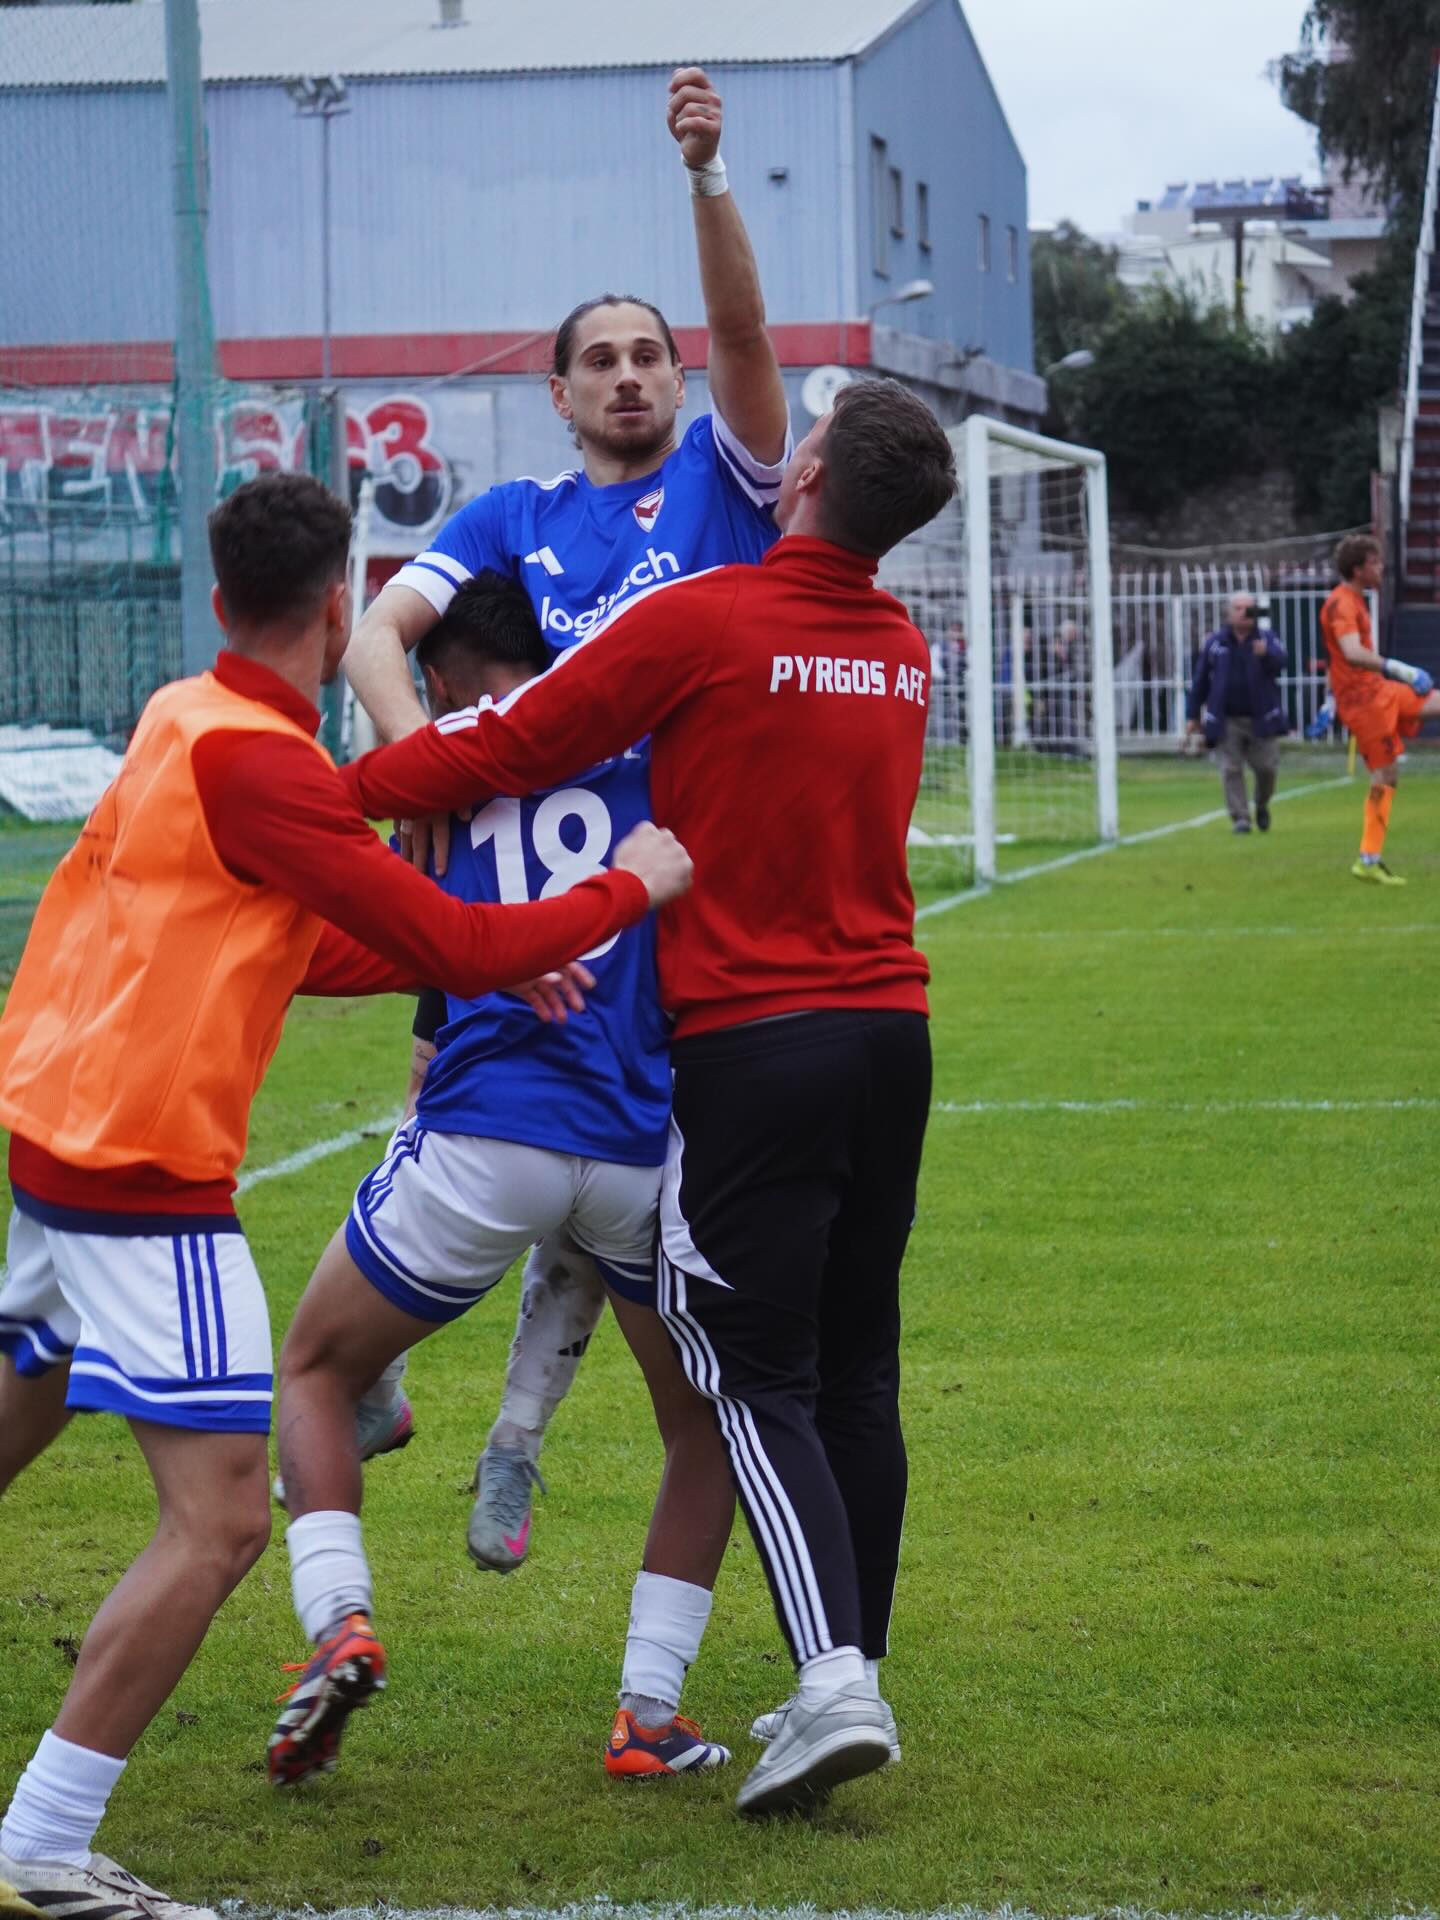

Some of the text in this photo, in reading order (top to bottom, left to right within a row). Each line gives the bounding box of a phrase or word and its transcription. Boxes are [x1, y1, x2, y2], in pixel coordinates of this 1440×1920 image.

[769, 655, 927, 707] PYRGOS AFC
[470, 787, 622, 961] 18
